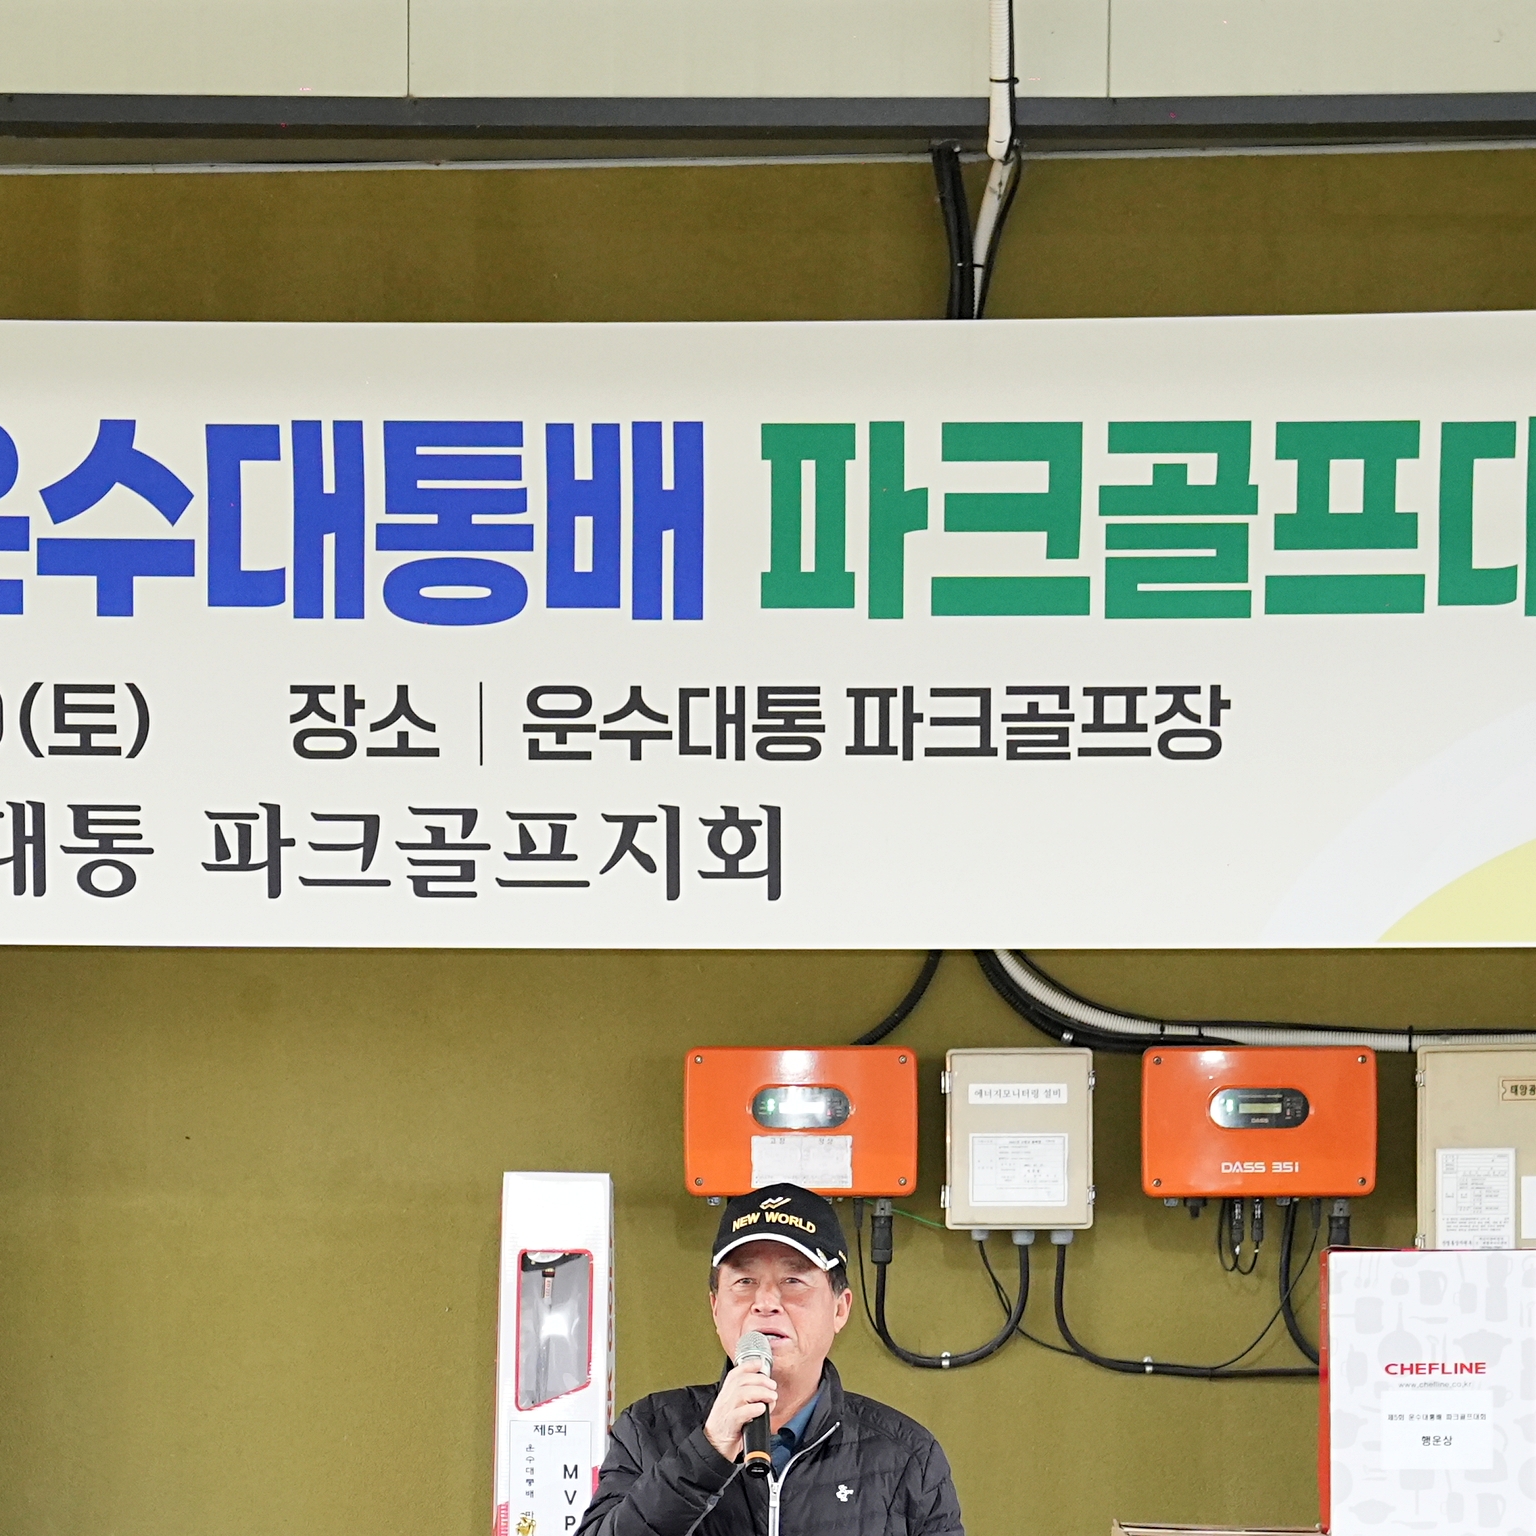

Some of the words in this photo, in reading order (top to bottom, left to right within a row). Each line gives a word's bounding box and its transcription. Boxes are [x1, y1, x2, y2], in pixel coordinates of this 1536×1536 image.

[289, 684, 440, 760] 장소
[522, 685, 826, 761] 운수대통
[845, 684, 1231, 761] 파크골프장
[201, 802, 783, 902] 파크골프지회
[974, 1088, 1039, 1099] 에너지모니터링
[1043, 1088, 1062, 1099] 설비
[1510, 1084, 1536, 1096] 태양광
[1221, 1161, 1266, 1173] DASS
[732, 1212, 761, 1233] NEW
[764, 1211, 816, 1234] WORLD
[1384, 1362, 1487, 1375] CHEFLINE
[1398, 1381, 1472, 1389] www.chefline.co.kr
[534, 1424, 567, 1436] 제5회
[1421, 1435, 1453, 1447] 행운상
